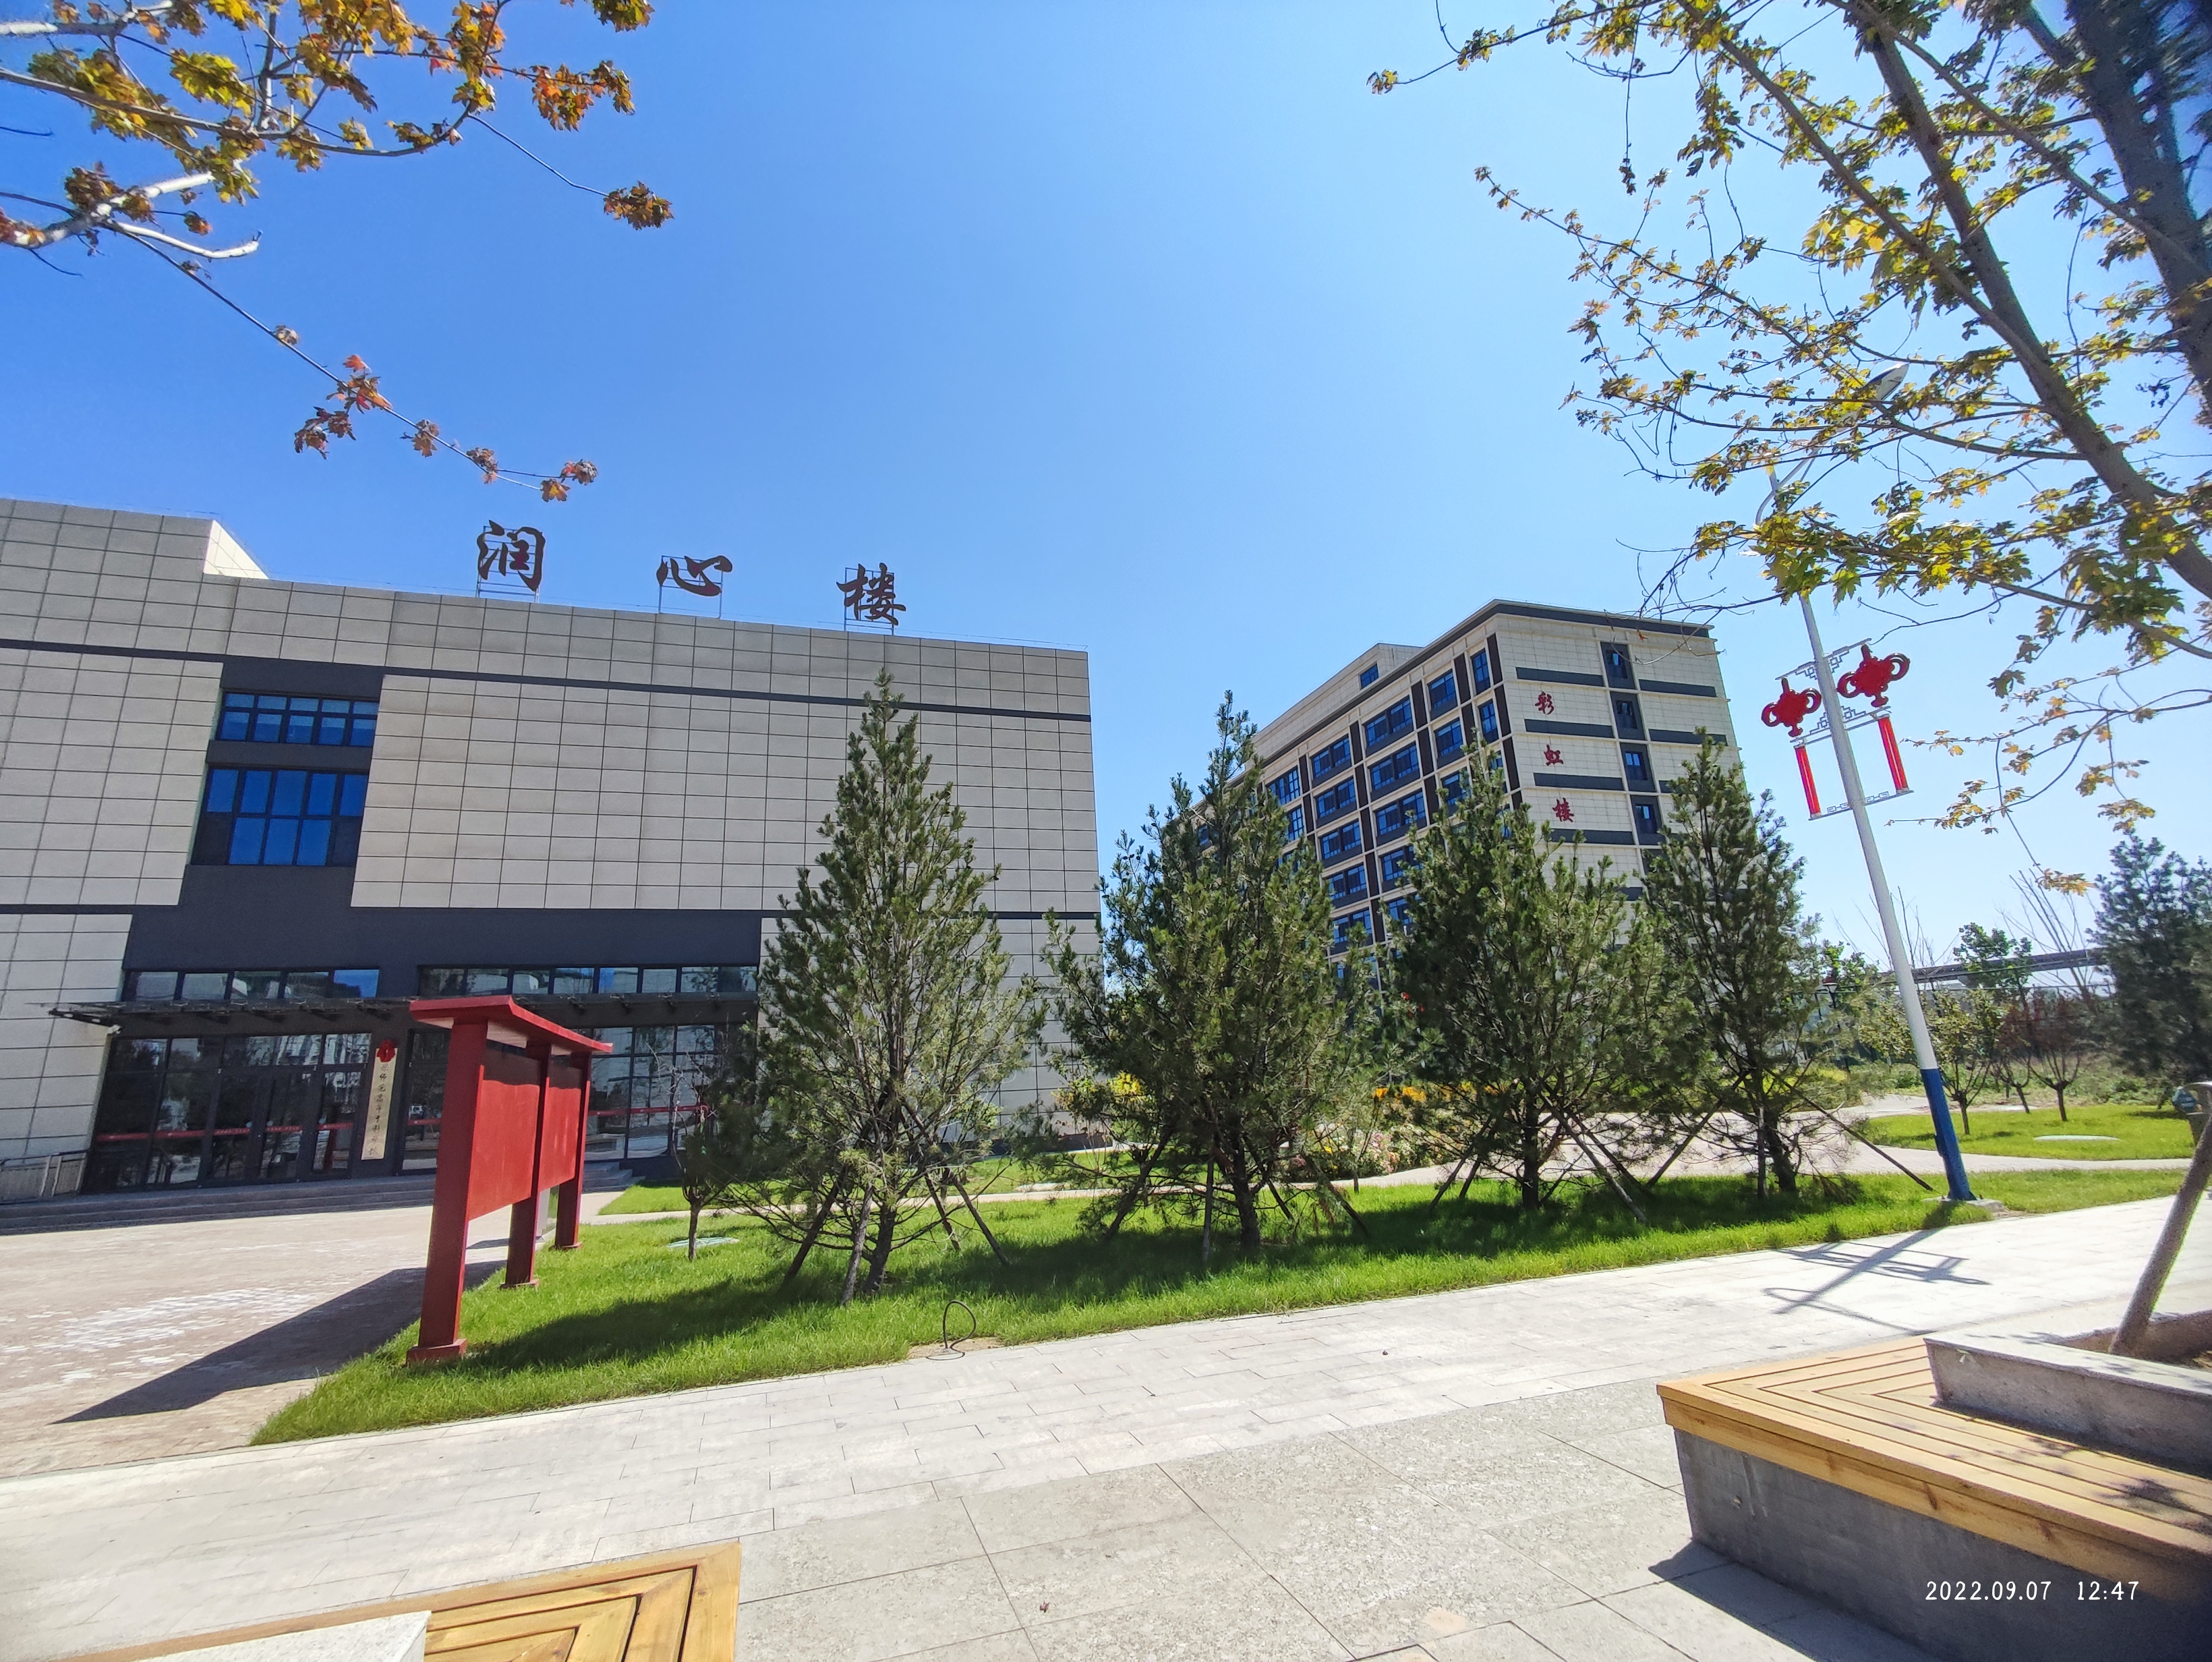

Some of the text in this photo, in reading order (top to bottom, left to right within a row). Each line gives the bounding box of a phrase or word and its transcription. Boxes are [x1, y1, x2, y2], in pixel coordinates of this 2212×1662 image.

[477, 520, 906, 626] 润心楼
[1535, 691, 1575, 823] 彩虹楼
